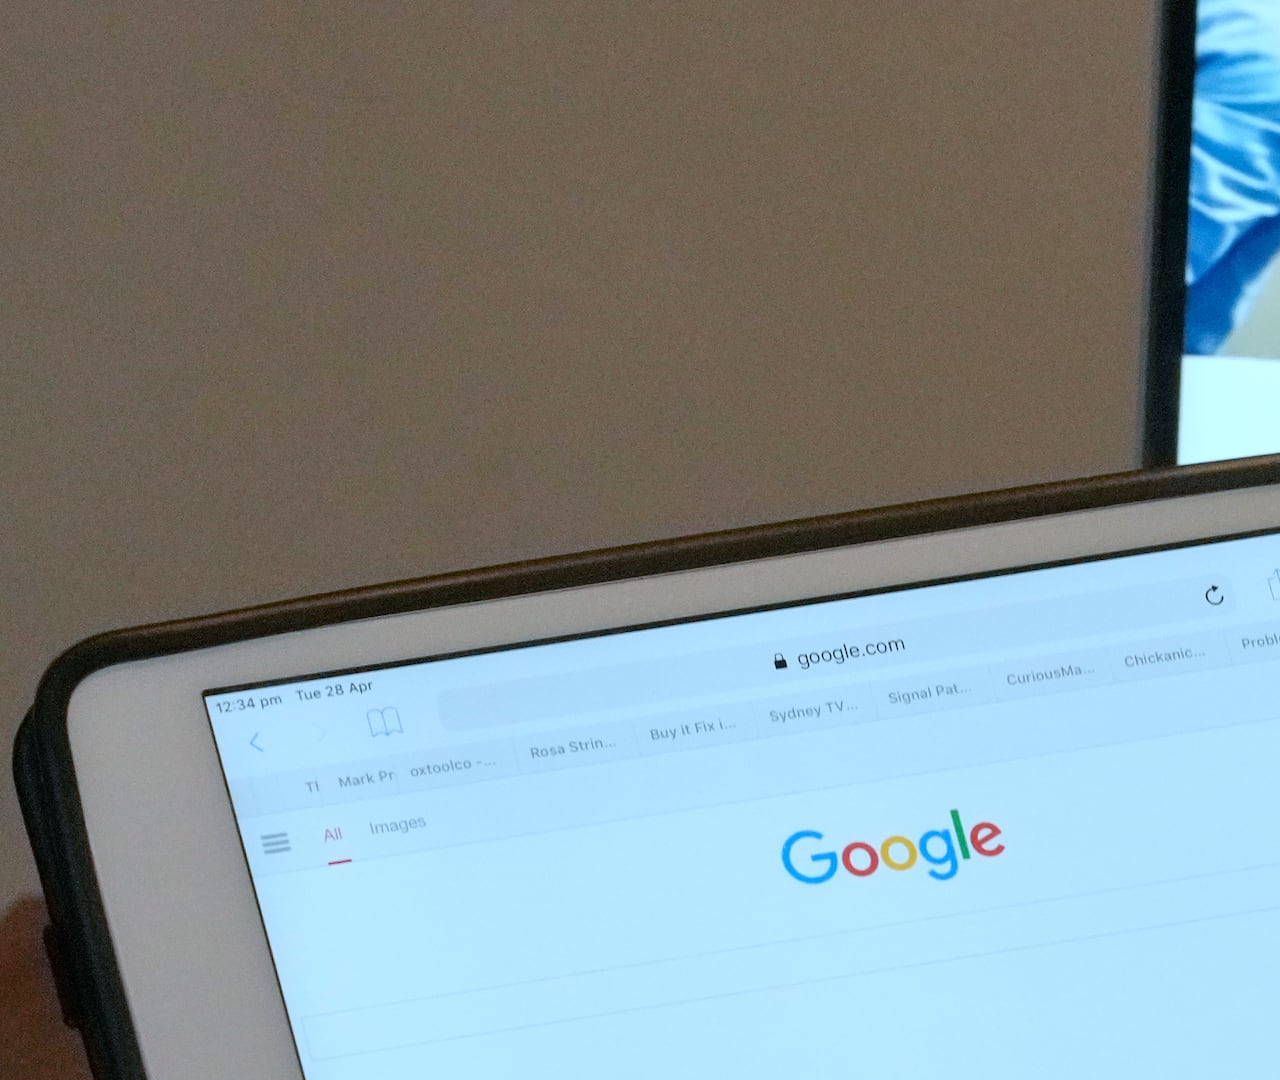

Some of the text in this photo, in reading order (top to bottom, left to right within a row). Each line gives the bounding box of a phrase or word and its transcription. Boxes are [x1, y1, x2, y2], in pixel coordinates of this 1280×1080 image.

[797, 637, 906, 670] google.com
[297, 681, 373, 702] Tue 28 Apr
[888, 687, 931, 705] Signal
[216, 695, 282, 713] 12:34 pm
[769, 703, 821, 724] Sydney
[650, 727, 678, 742] Buy
[680, 723, 691, 735] it
[694, 719, 716, 732] Fix
[530, 742, 566, 760] Rosa
[410, 757, 472, 777] oxtoolco
[338, 772, 375, 788] Mark
[324, 816, 426, 842] All Images
[781, 809, 1006, 885] Google
